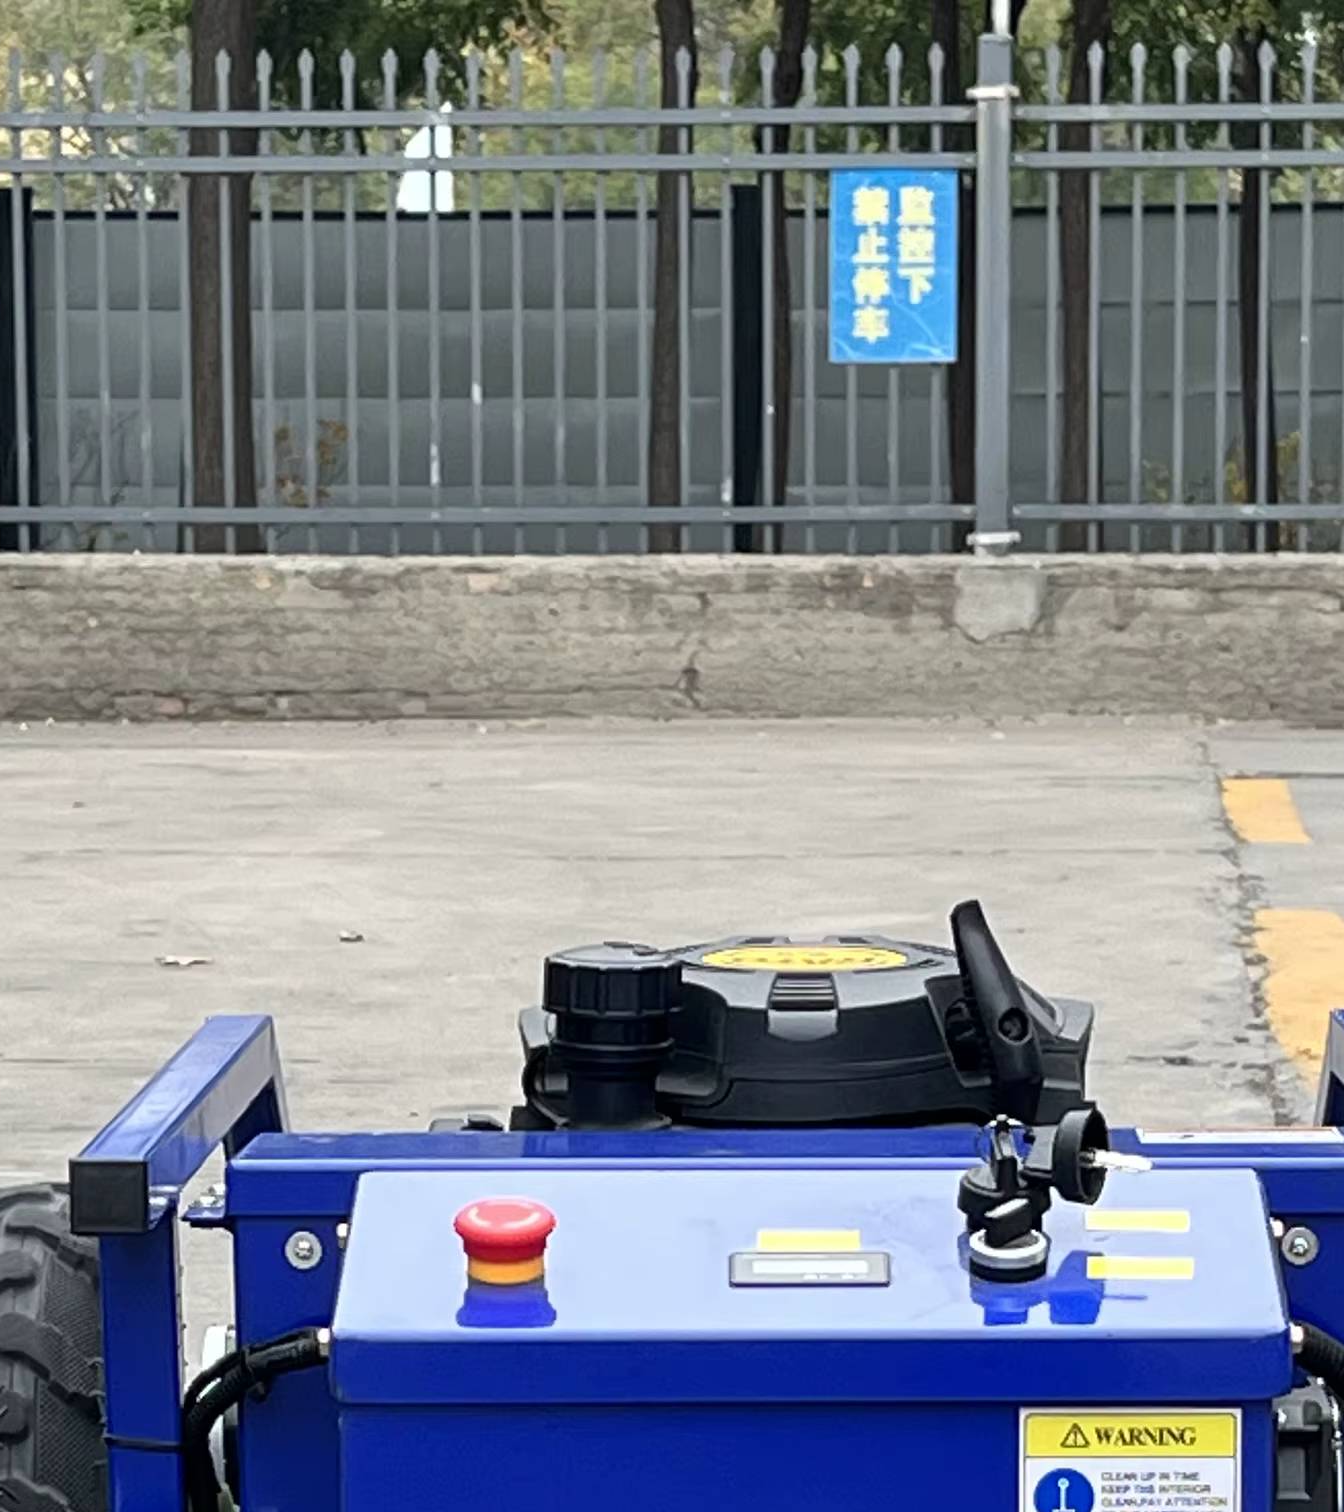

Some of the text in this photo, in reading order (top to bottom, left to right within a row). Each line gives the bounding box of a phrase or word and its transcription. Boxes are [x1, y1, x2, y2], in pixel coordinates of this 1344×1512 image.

[1095, 1427, 1197, 1446] WARNING
[1173, 1472, 1199, 1482] TIME
[1158, 1484, 1211, 1494] INTERIOR
[1164, 1497, 1228, 1507] ATTENTION
